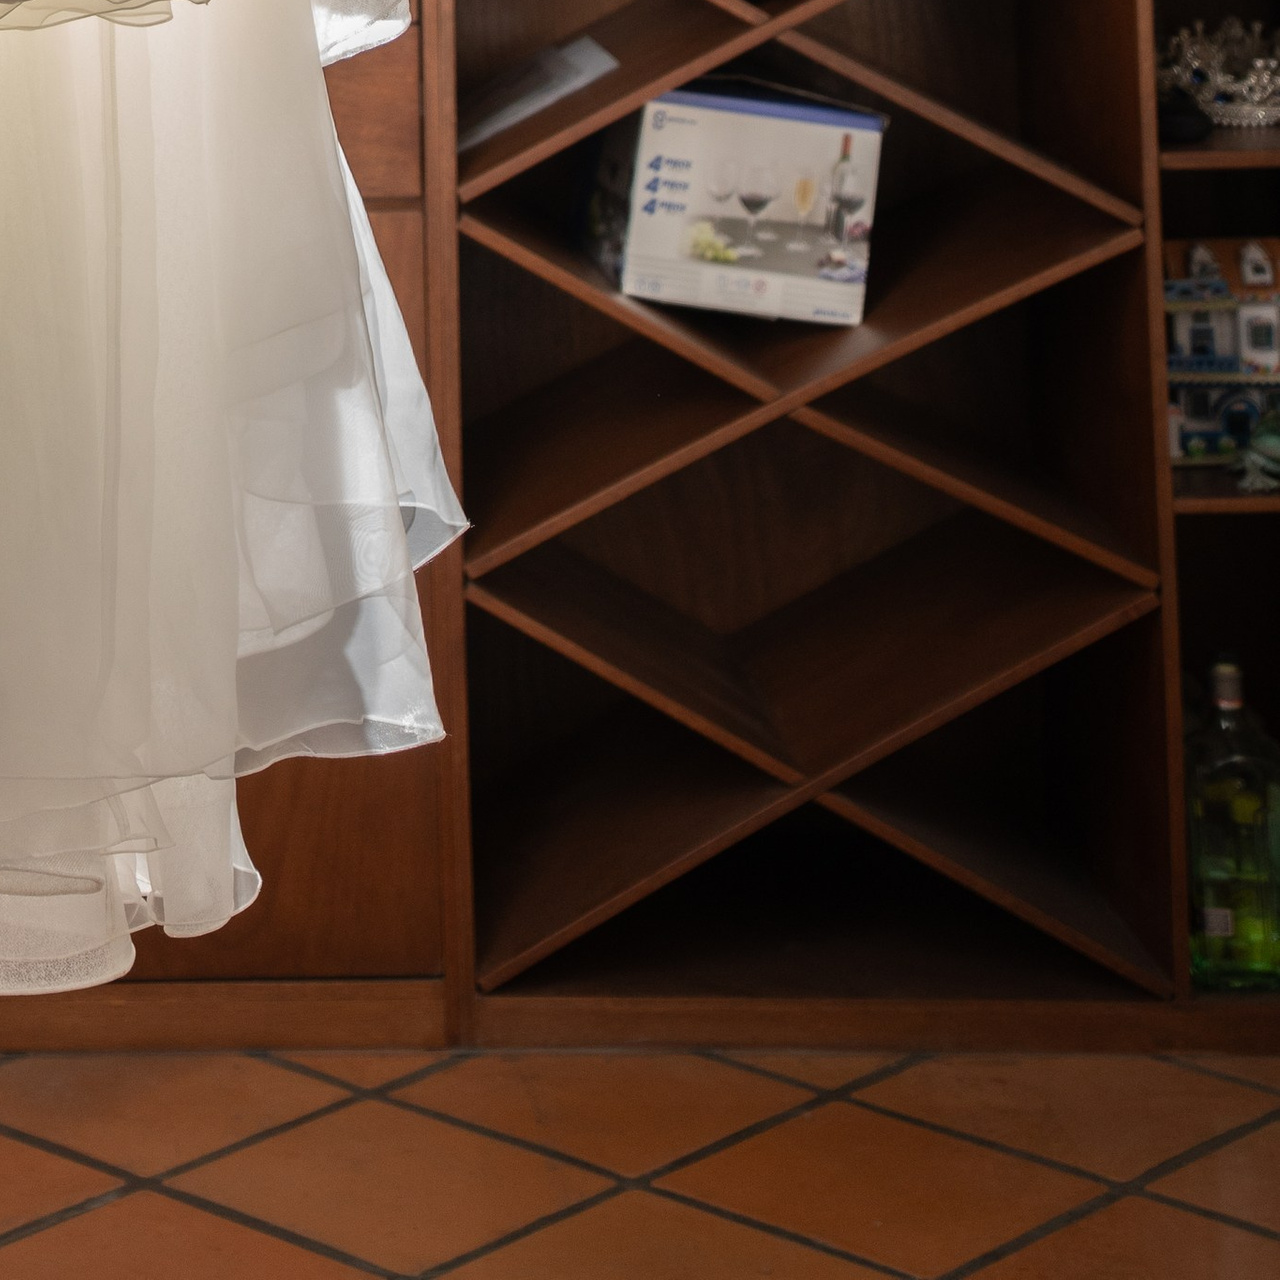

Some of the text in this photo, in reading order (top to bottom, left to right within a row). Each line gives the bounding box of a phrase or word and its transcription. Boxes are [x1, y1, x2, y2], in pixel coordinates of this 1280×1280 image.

[648, 155, 662, 171] 4
[645, 177, 659, 193] 4
[643, 199, 657, 215] 4
